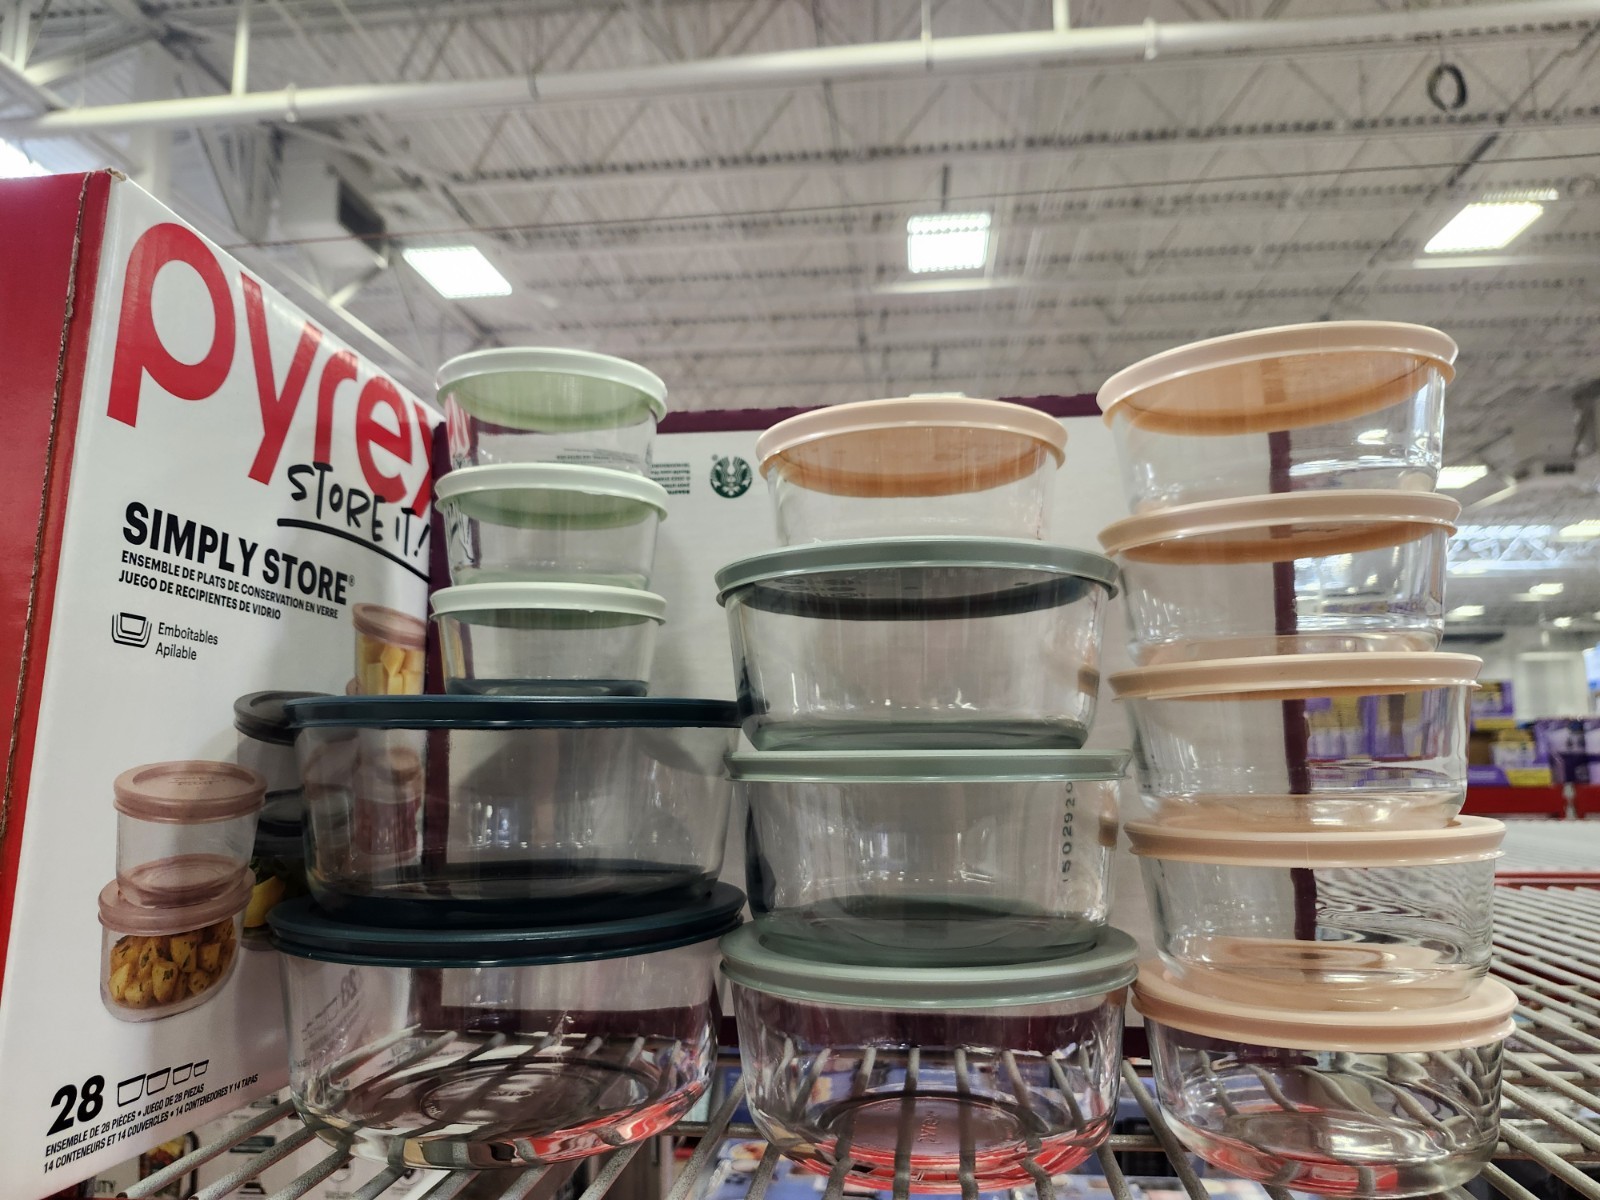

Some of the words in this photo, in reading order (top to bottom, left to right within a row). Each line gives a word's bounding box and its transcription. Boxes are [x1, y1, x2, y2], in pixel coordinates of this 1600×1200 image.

[123, 501, 258, 577] SIMPLY
[288, 461, 386, 542] STORE
[396, 507, 430, 557] IT!
[118, 569, 158, 590] JUEGO
[160, 579, 174, 594] DE
[175, 584, 238, 610] RECIPIENTES
[239, 600, 251, 613] DE
[252, 603, 281, 620] VIDRIO
[121, 550, 180, 577] ENSEMBLE
[182, 567, 196, 581] DE
[197, 571, 226, 589] PLATS
[228, 579, 240, 593] DE
[241, 583, 304, 610] CONSERVATION
[305, 601, 315, 613] EN
[316, 604, 339, 619] VERRE
[155, 642, 197, 661] Apilable
[158, 621, 219, 645] Emboîtables
[44, 1160, 54, 1174] 14
[55, 1138, 106, 1168] CONTENEURS
[106, 1133, 116, 1147] ET
[117, 1129, 127, 1142] 14
[127, 1110, 169, 1138] COUVERCLES
[176, 1105, 184, 1117] 14
[184, 1086, 229, 1112] CONTENEDORES
[229, 1083, 234, 1094] Y
[234, 1080, 241, 1091] 14
[241, 1073, 259, 1088] TAPAS
[45, 1129, 88, 1157] ENSEMBLE
[89, 1124, 100, 1139] DE
[101, 1121, 111, 1135] 28
[111, 1110, 136, 1130] PIÈCES
[142, 1099, 164, 1117] JUEGO
[164, 1095, 174, 1108] DE
[174, 1092, 183, 1104] 28
[183, 1083, 205, 1100] PIEZAS
[46, 1074, 105, 1137] 28
